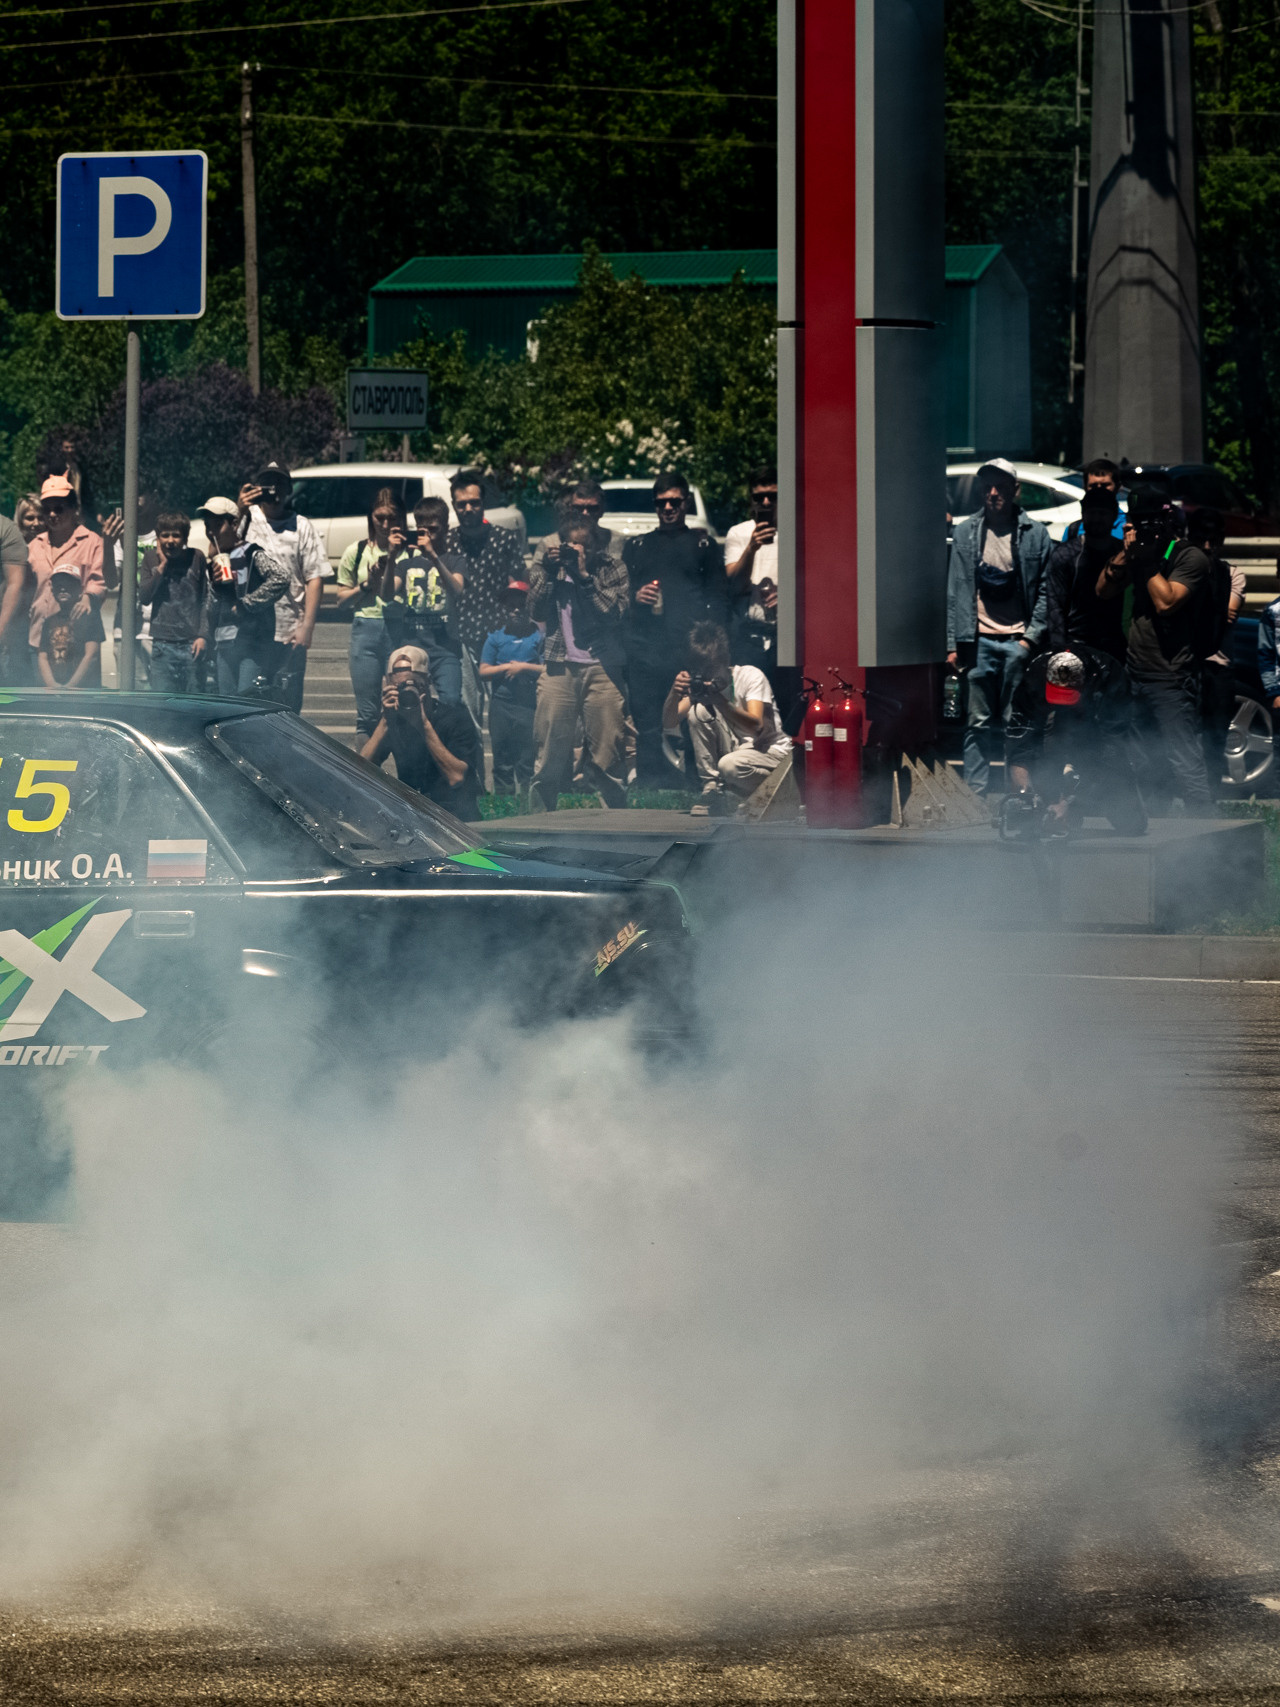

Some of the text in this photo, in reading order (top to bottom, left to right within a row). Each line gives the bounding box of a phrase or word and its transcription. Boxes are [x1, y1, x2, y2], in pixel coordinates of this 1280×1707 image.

[98, 176, 172, 297] P
[352, 385, 424, 415] СТАВРОПОЛЬ
[71, 853, 133, 880] О.А.
